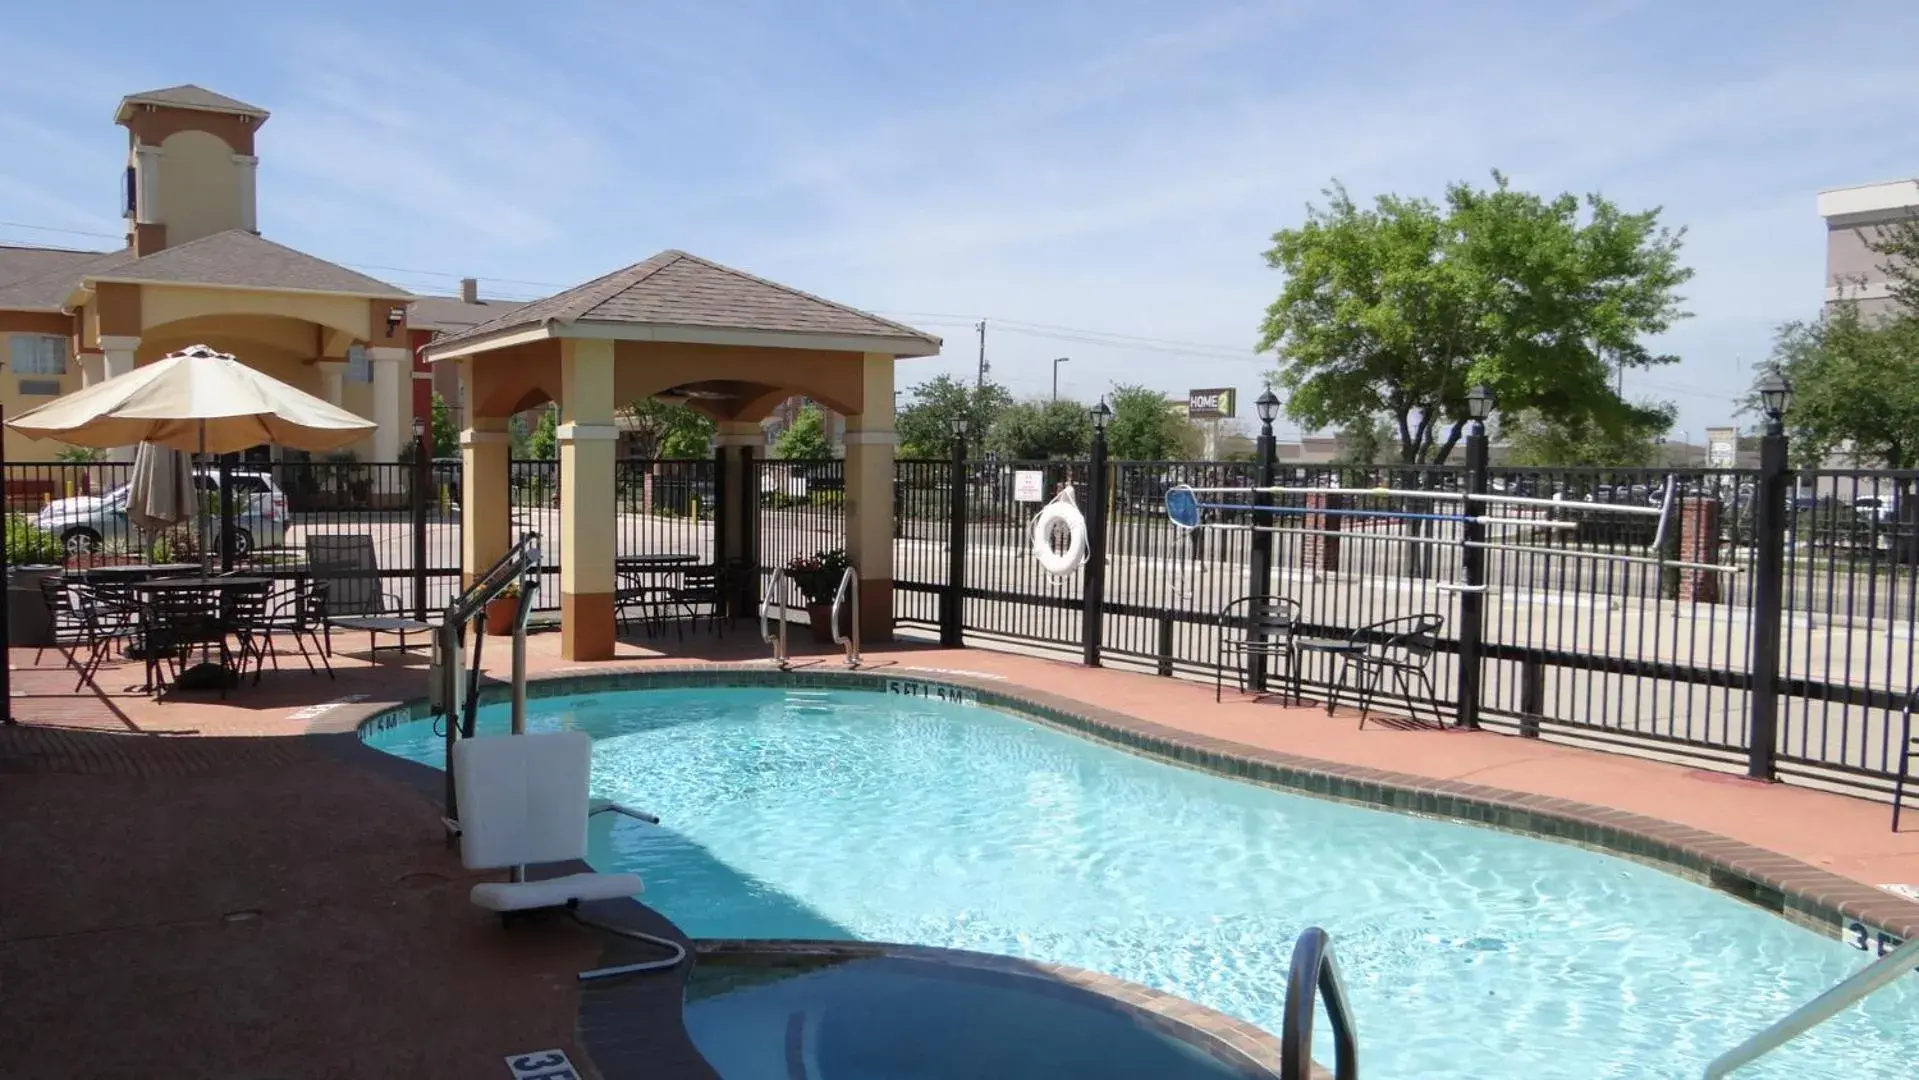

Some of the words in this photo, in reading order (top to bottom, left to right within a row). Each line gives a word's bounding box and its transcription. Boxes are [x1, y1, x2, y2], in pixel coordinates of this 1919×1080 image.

[1190, 395, 1218, 408] HOME
[890, 682, 899, 694] 5
[1849, 923, 1869, 951] 3
[513, 1054, 566, 1071] 3
